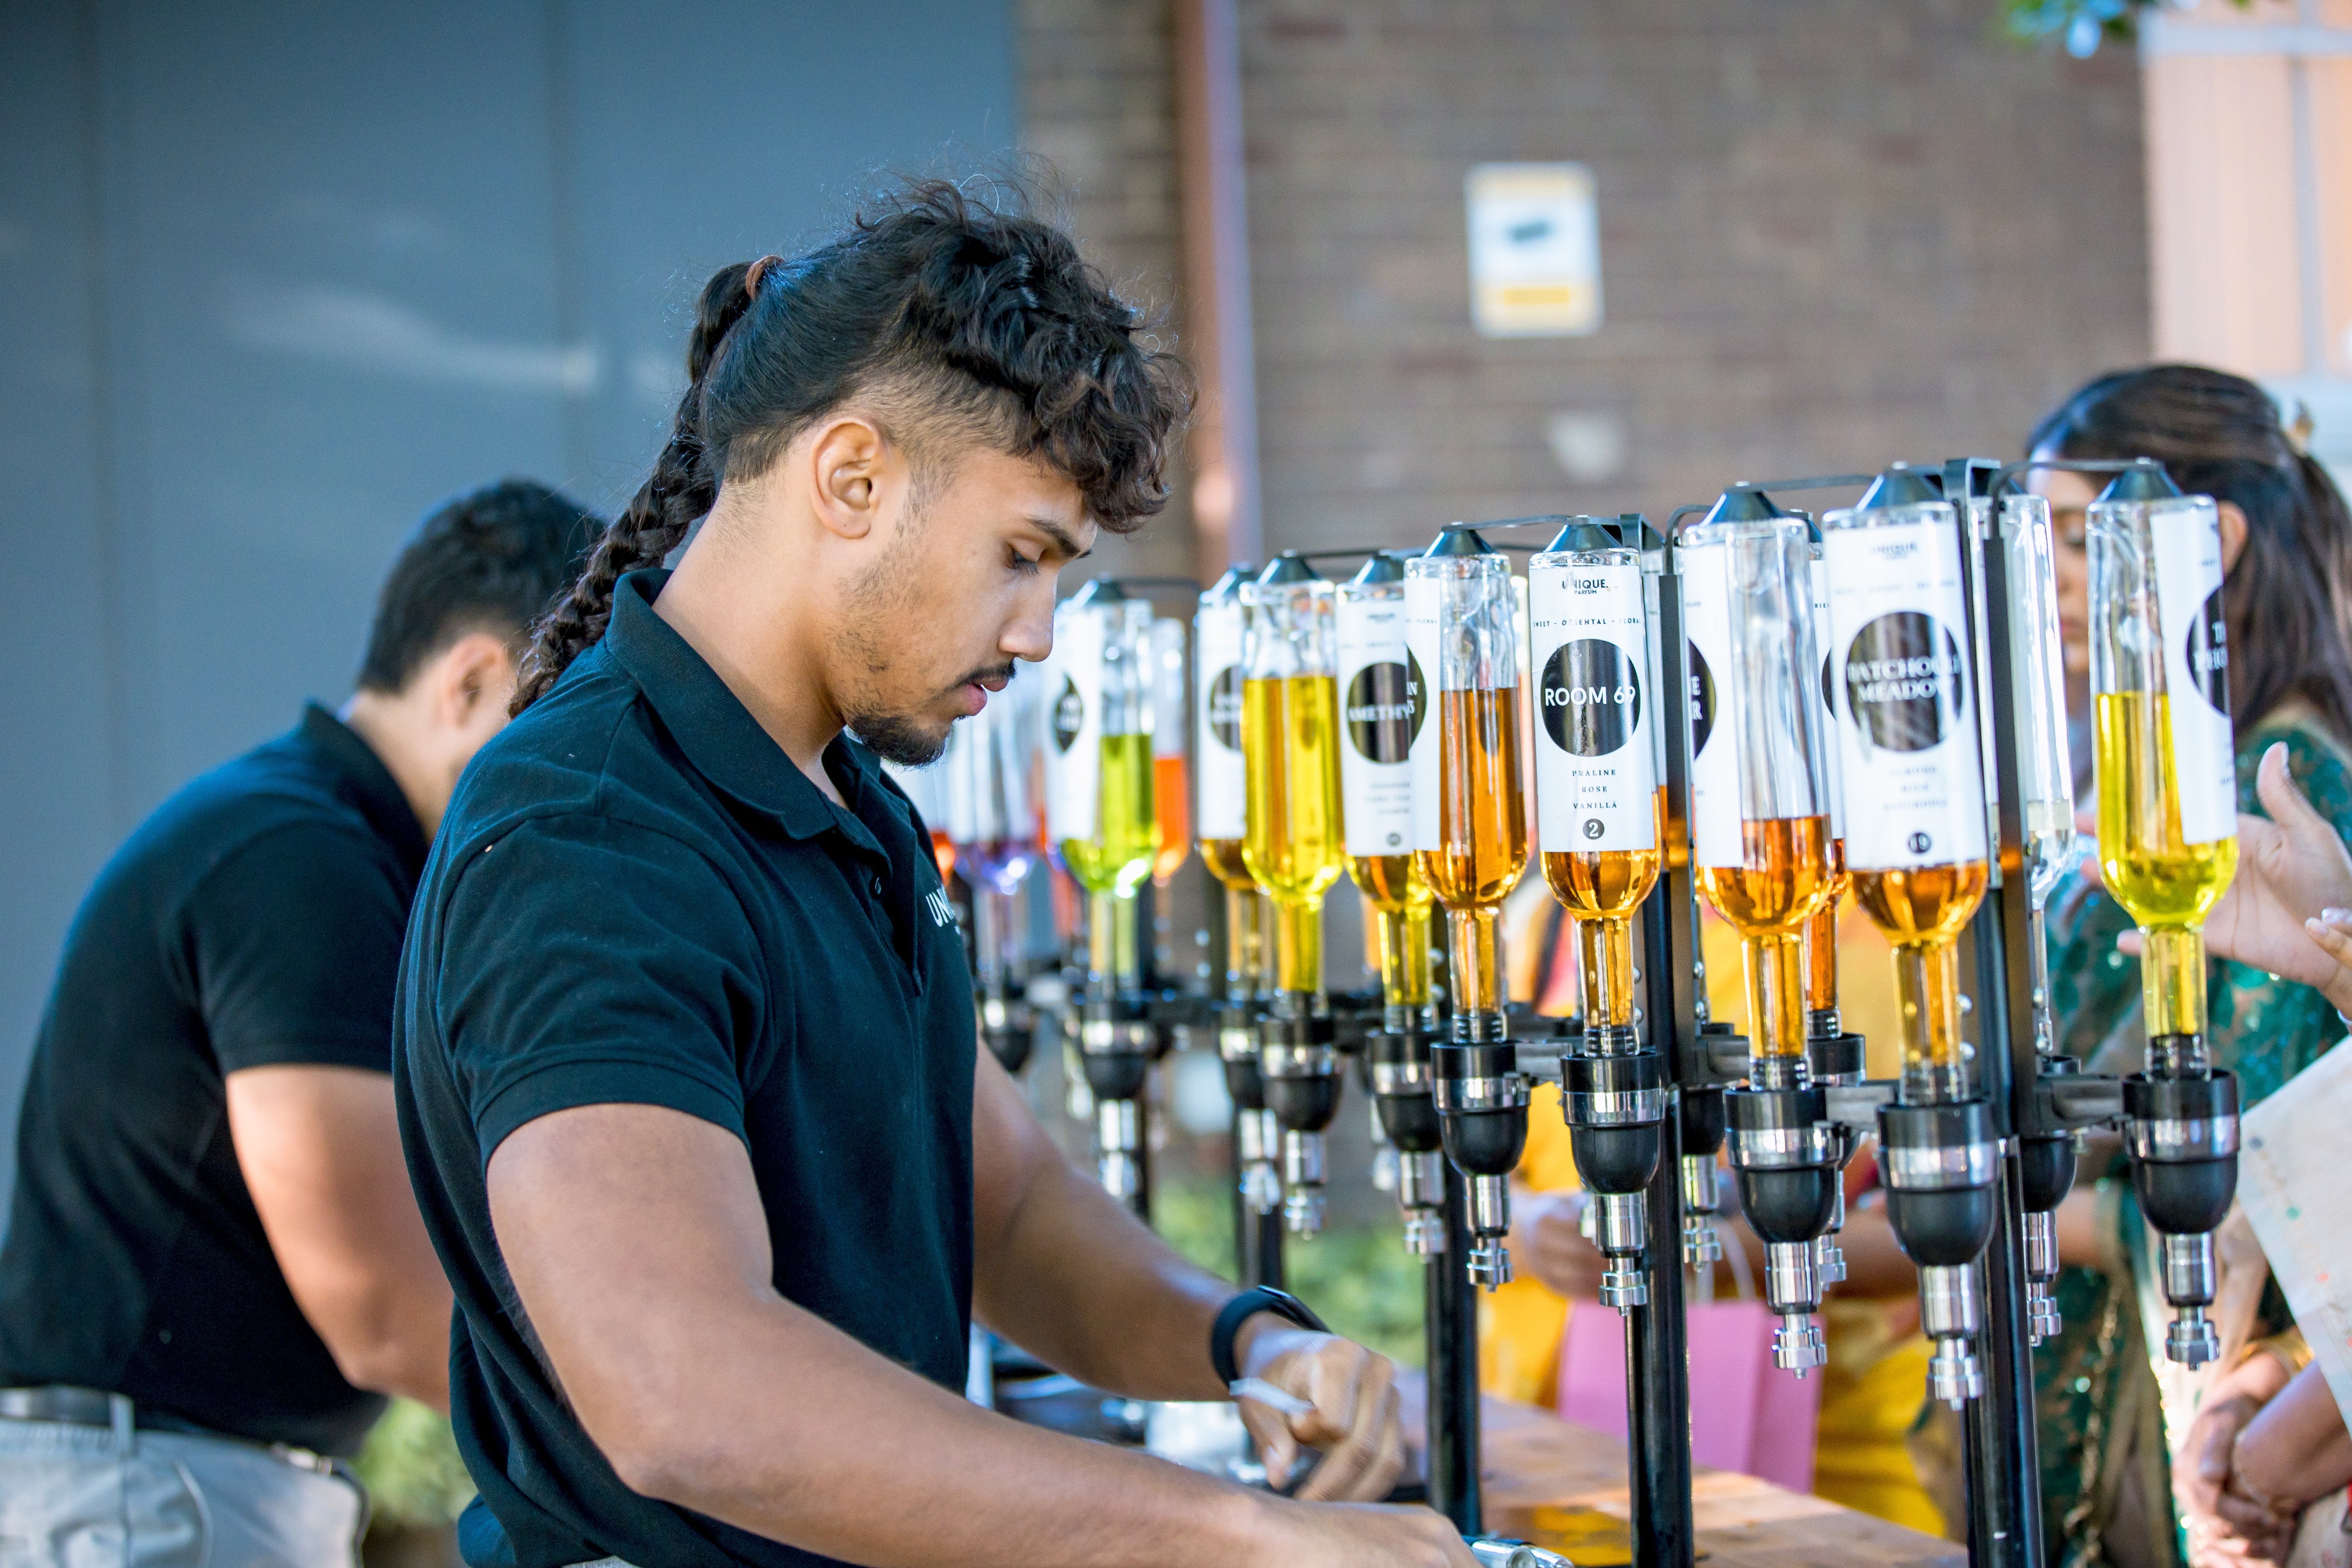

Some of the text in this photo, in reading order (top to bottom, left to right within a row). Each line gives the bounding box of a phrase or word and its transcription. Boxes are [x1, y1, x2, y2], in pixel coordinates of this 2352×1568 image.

[1545, 686, 1636, 706] ROOM 69
[1857, 677, 1956, 703] MEADO
[1589, 822, 1599, 837] 2
